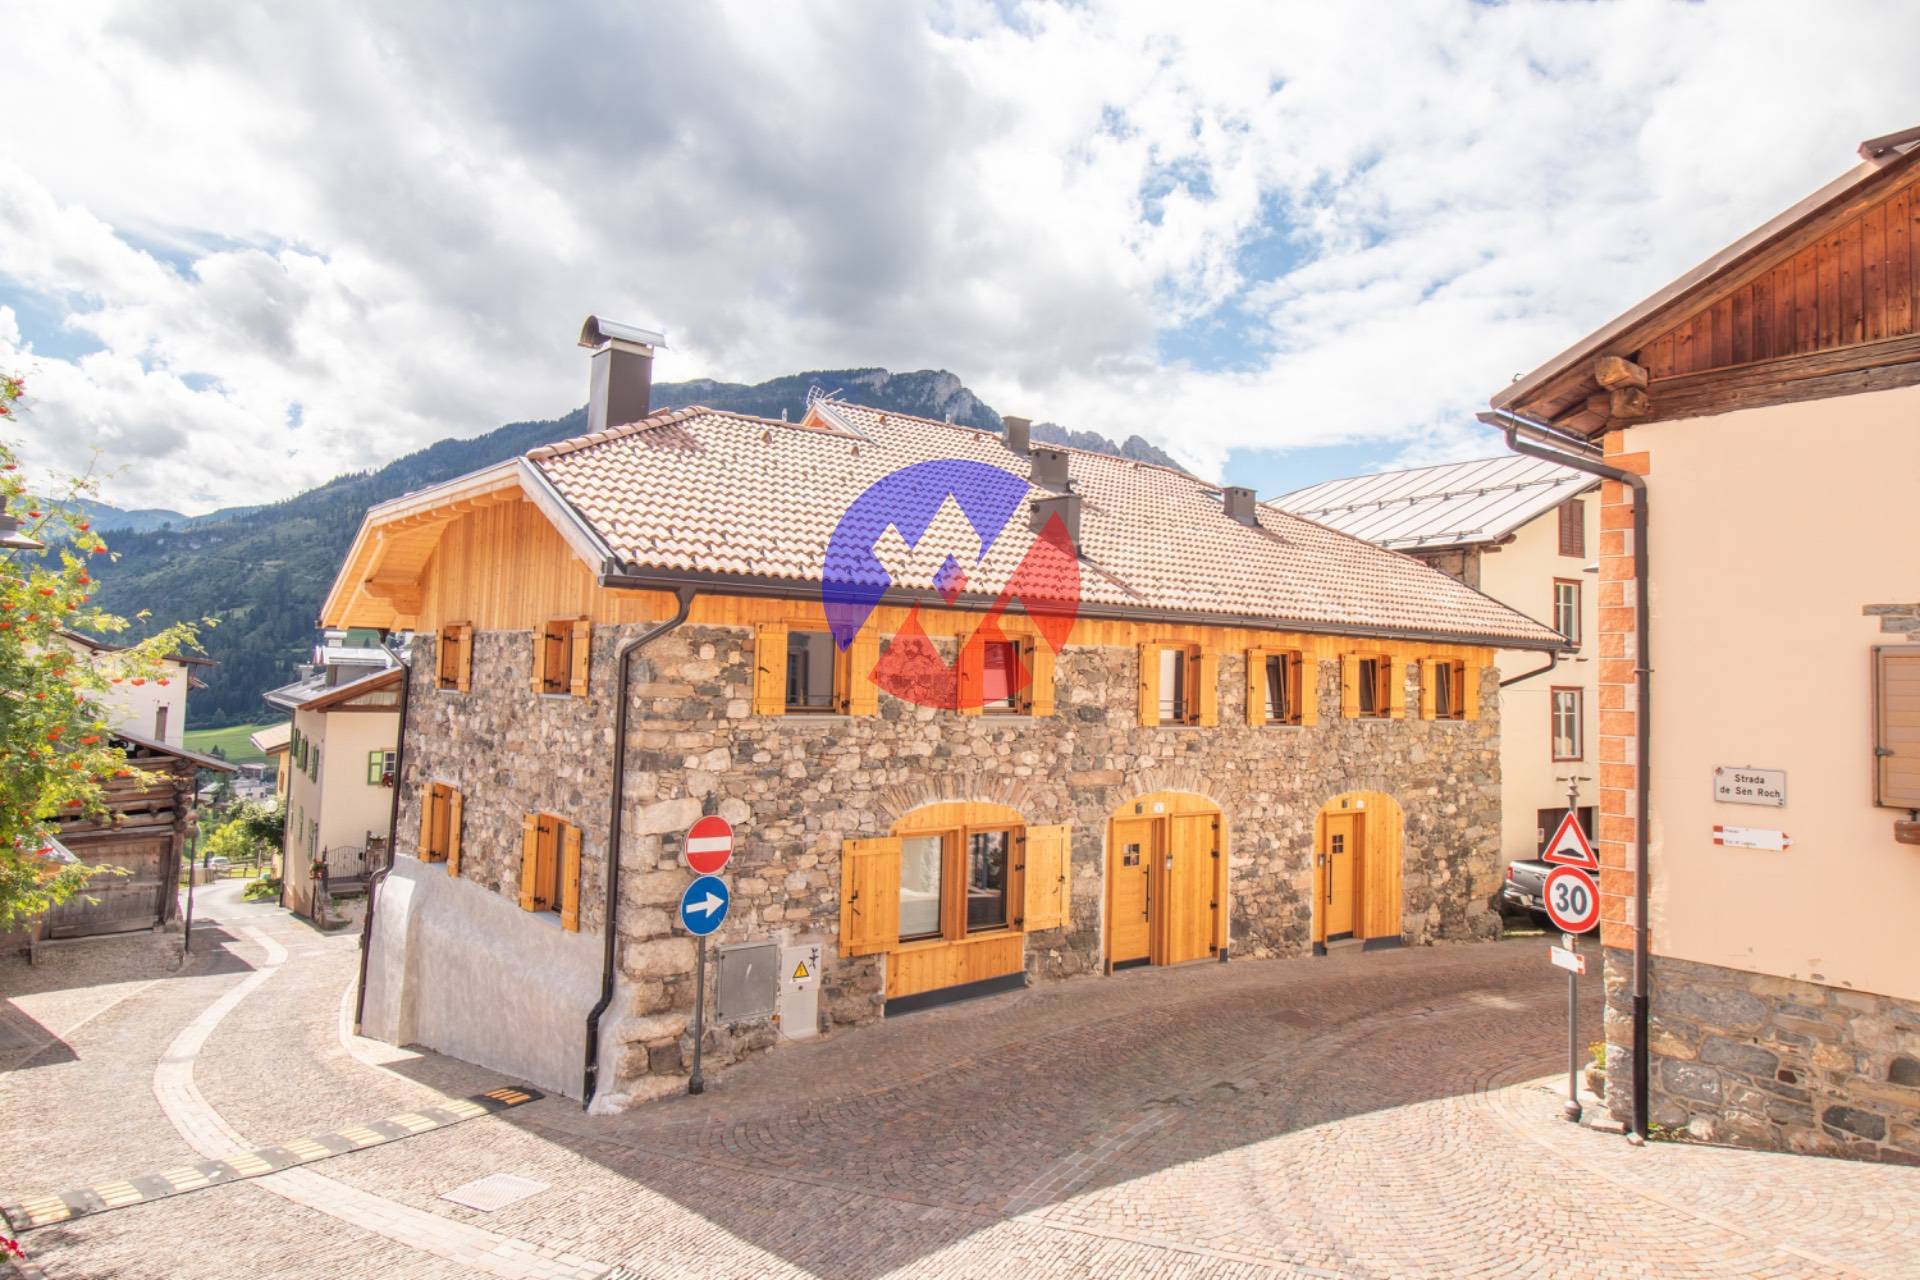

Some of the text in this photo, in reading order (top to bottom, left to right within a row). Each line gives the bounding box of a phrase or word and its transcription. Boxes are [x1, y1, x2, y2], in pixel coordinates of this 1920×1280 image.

[1735, 774, 1765, 784] Strada
[1720, 786, 1730, 794] de
[1757, 788, 1780, 797] Roch
[1555, 883, 1587, 915] 30
